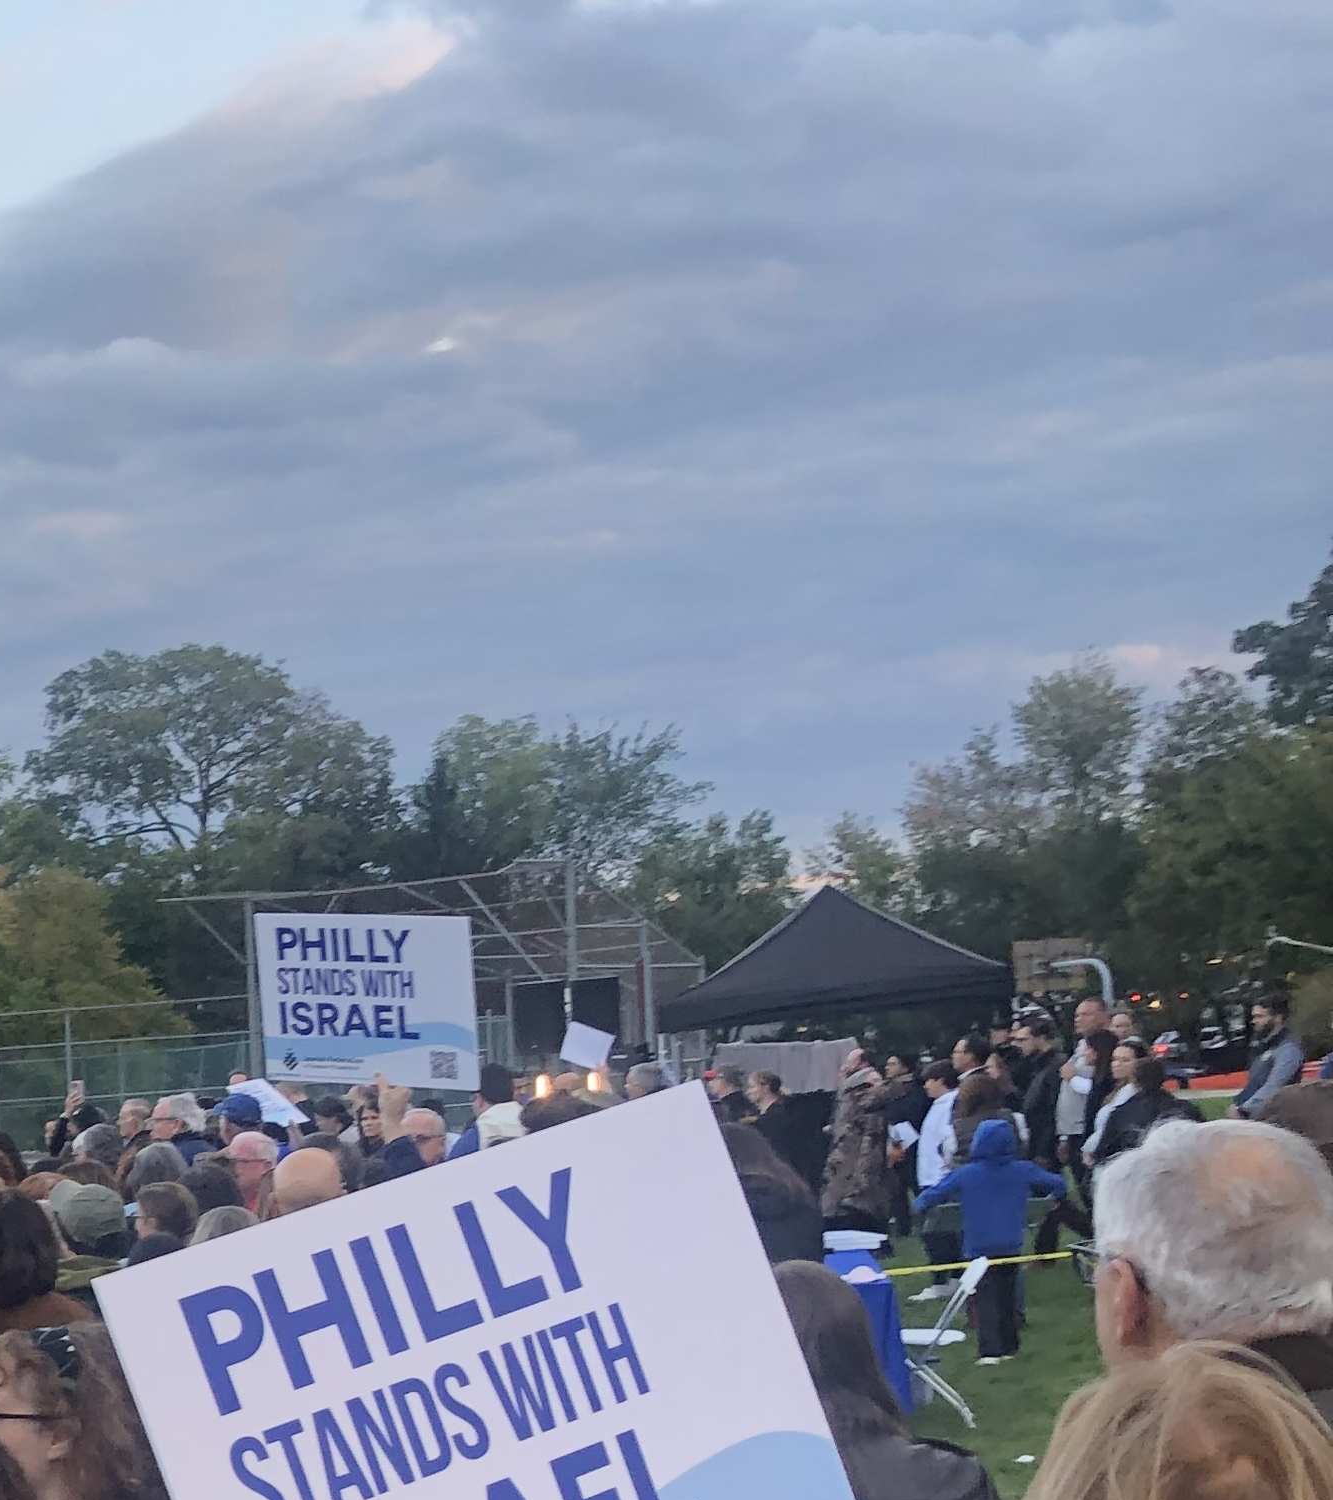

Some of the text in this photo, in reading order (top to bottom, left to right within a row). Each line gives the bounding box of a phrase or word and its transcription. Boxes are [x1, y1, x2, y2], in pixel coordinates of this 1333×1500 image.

[275, 927, 412, 963] PHILLY
[276, 968, 415, 998] STANDS WITH
[279, 1001, 421, 1040] ISRAEL
[178, 1165, 583, 1417] PHILLY
[480, 1303, 651, 1442] WITH
